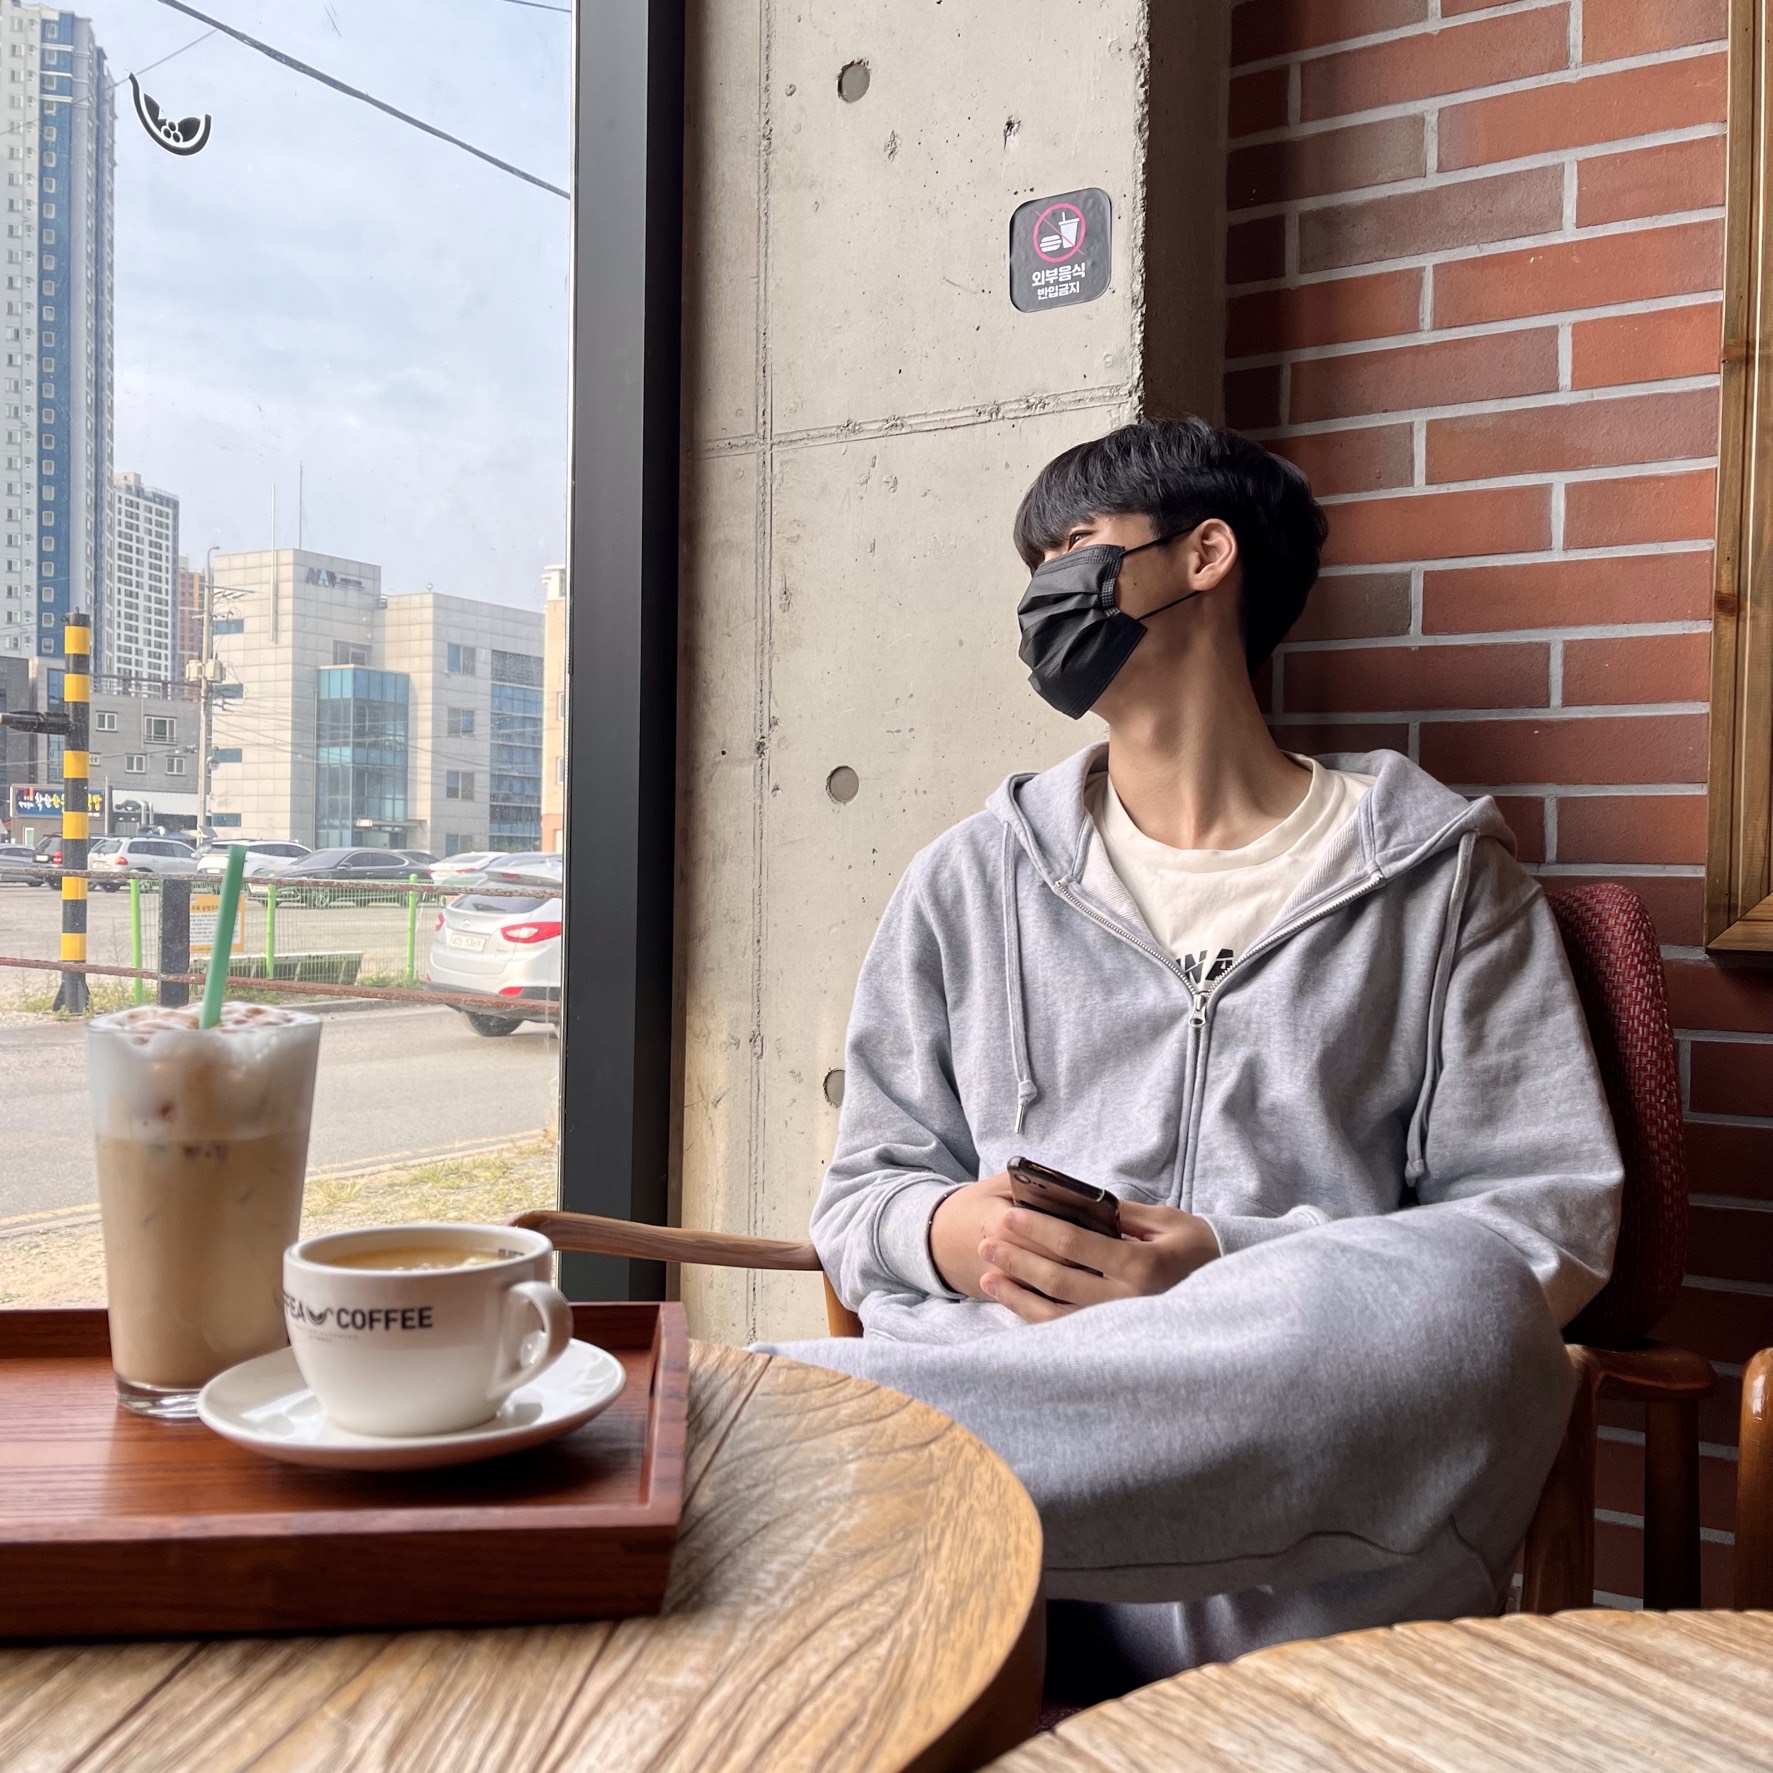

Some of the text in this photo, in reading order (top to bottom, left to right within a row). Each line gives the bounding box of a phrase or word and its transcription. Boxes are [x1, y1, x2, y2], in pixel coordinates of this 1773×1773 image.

[1031, 262, 1086, 287] 외부음식
[1037, 281, 1080, 301] 반입금지
[336, 1306, 434, 1331] COFFEE
